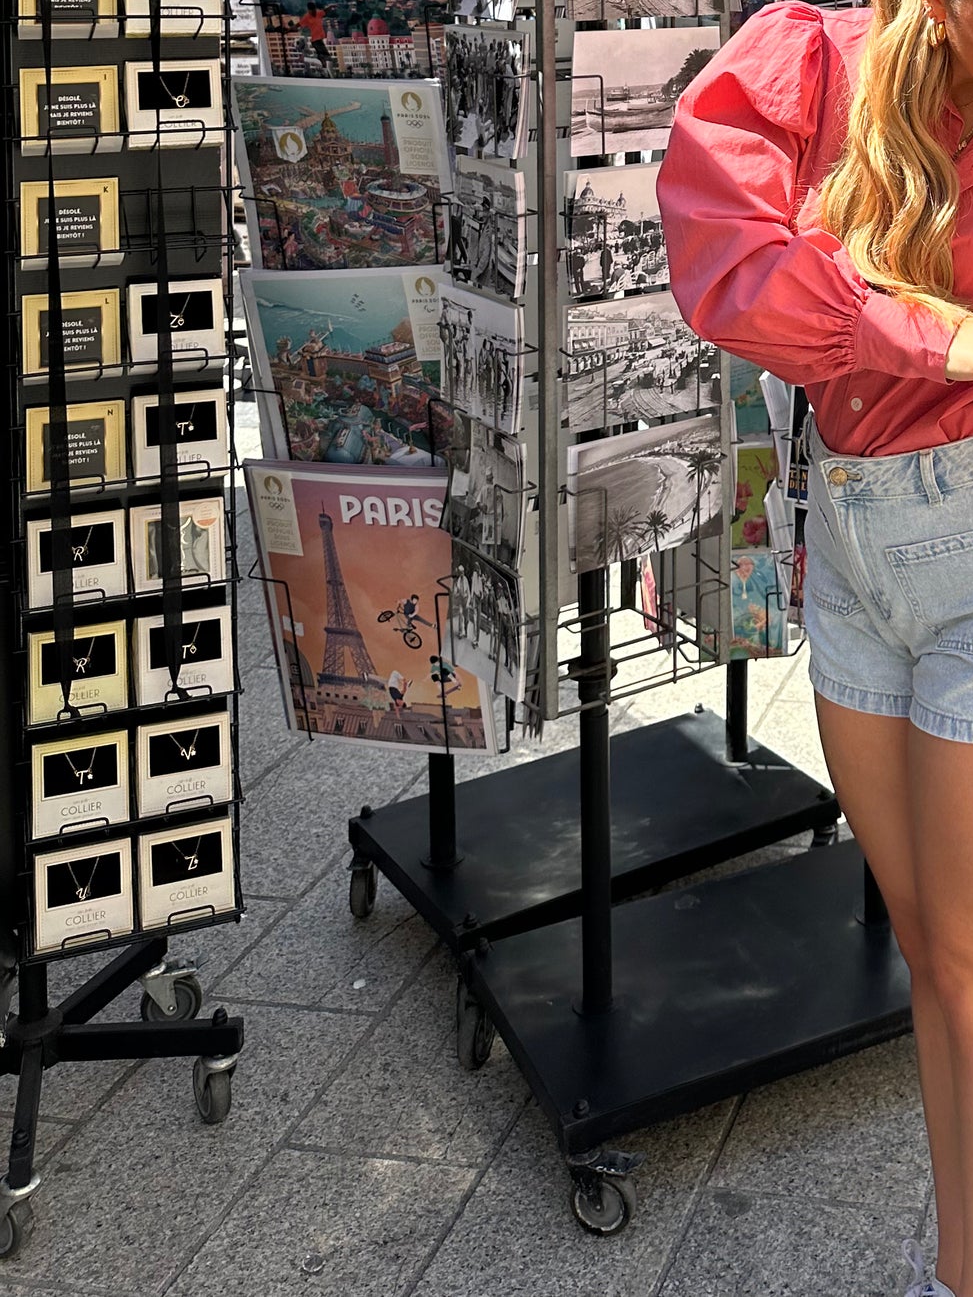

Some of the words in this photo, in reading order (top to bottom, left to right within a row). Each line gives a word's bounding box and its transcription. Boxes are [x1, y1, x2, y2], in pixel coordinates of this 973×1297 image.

[339, 494, 443, 527] PARIS
[75, 578, 99, 588] LLIER
[168, 675, 206, 687] COLLIER
[166, 781, 206, 795] COLLIER
[61, 802, 102, 816] COLLIER
[169, 887, 208, 901] COLLIER
[65, 911, 106, 926] COLLIER
